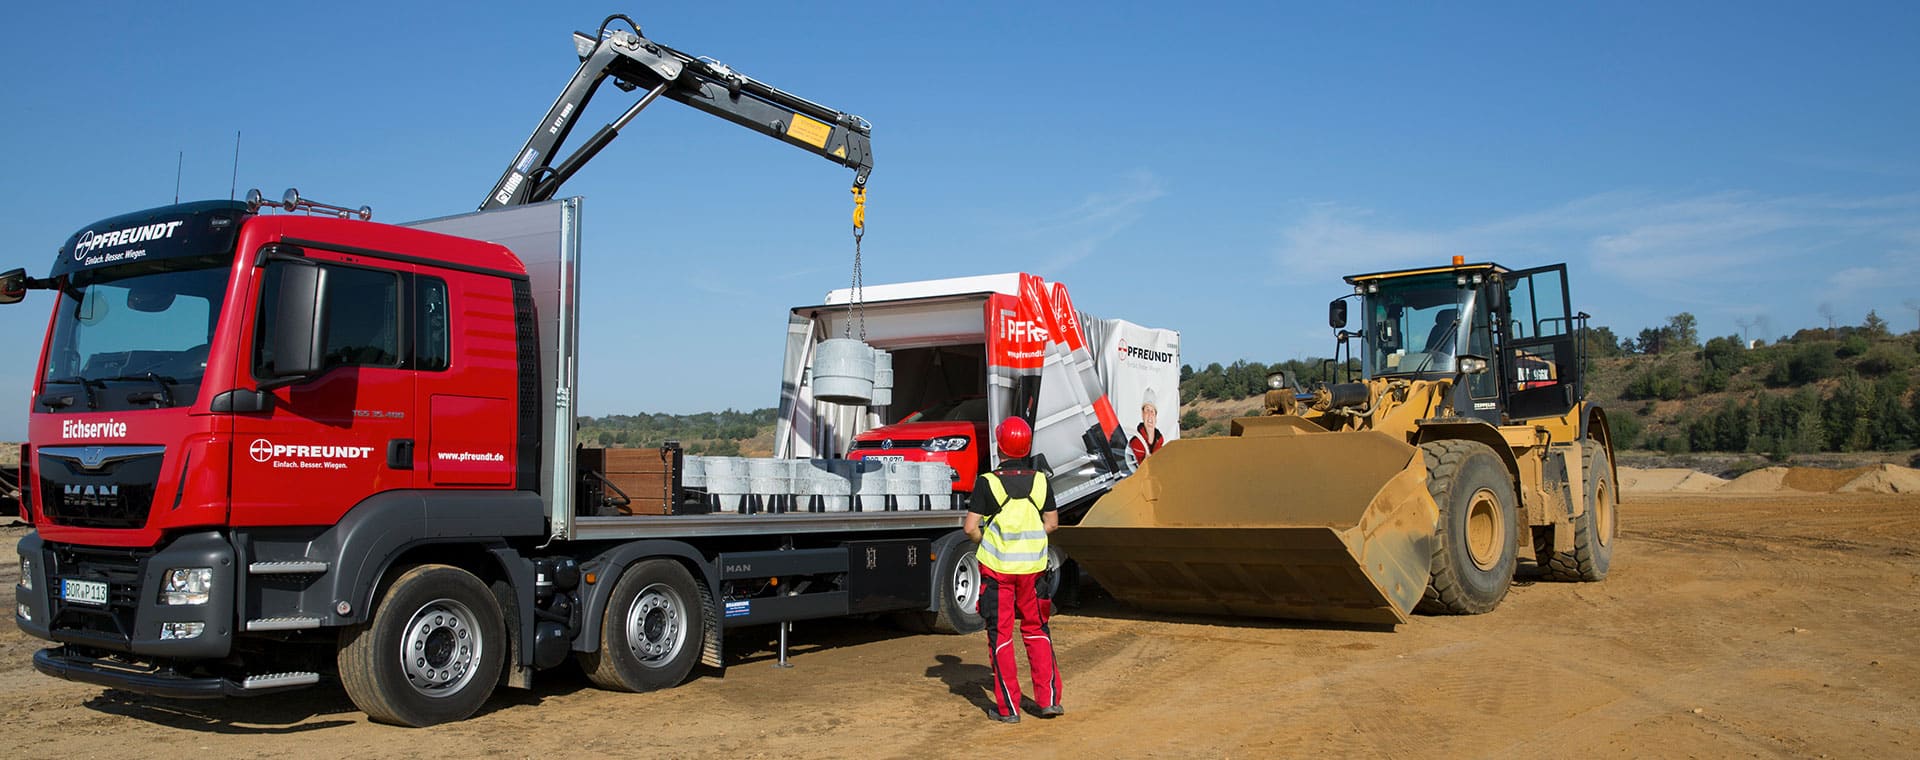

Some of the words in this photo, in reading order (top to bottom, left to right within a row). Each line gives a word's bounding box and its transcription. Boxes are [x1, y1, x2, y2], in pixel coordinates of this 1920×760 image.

[503, 172, 523, 194] HIAB
[89, 221, 183, 251] PFREUNDT
[1127, 346, 1173, 363] PFREUNDT
[62, 418, 127, 439] Eichservice
[273, 445, 375, 459] PFREUNDT
[437, 452, 504, 462] www.pfreundt.de
[273, 460, 299, 468] Einfach.
[300, 461, 323, 469] Besser.
[323, 461, 348, 470] Wiegen.
[64, 484, 118, 506] MAN
[726, 564, 751, 573] MAN
[66, 582, 80, 598] BOR
